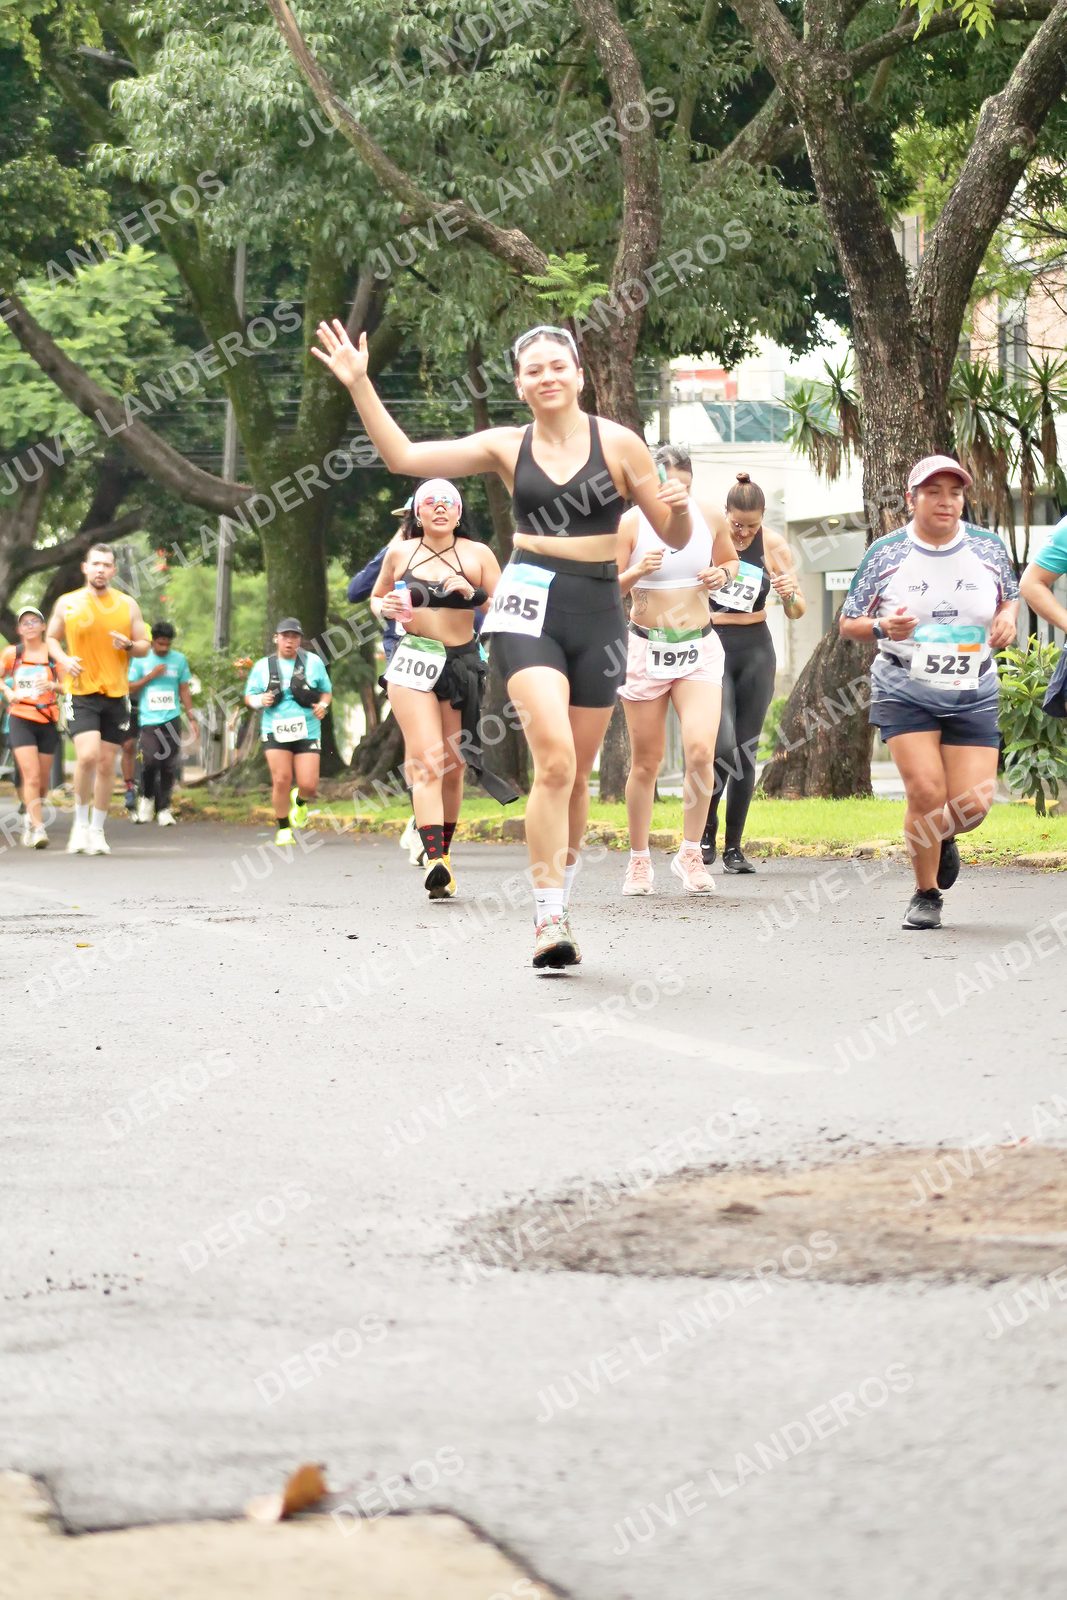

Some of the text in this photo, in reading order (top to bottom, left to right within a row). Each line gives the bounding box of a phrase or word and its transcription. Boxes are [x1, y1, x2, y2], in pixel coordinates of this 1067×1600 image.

[393, 656, 438, 680] 2100
[651, 649, 699, 666] 1979
[924, 654, 971, 675] 523
